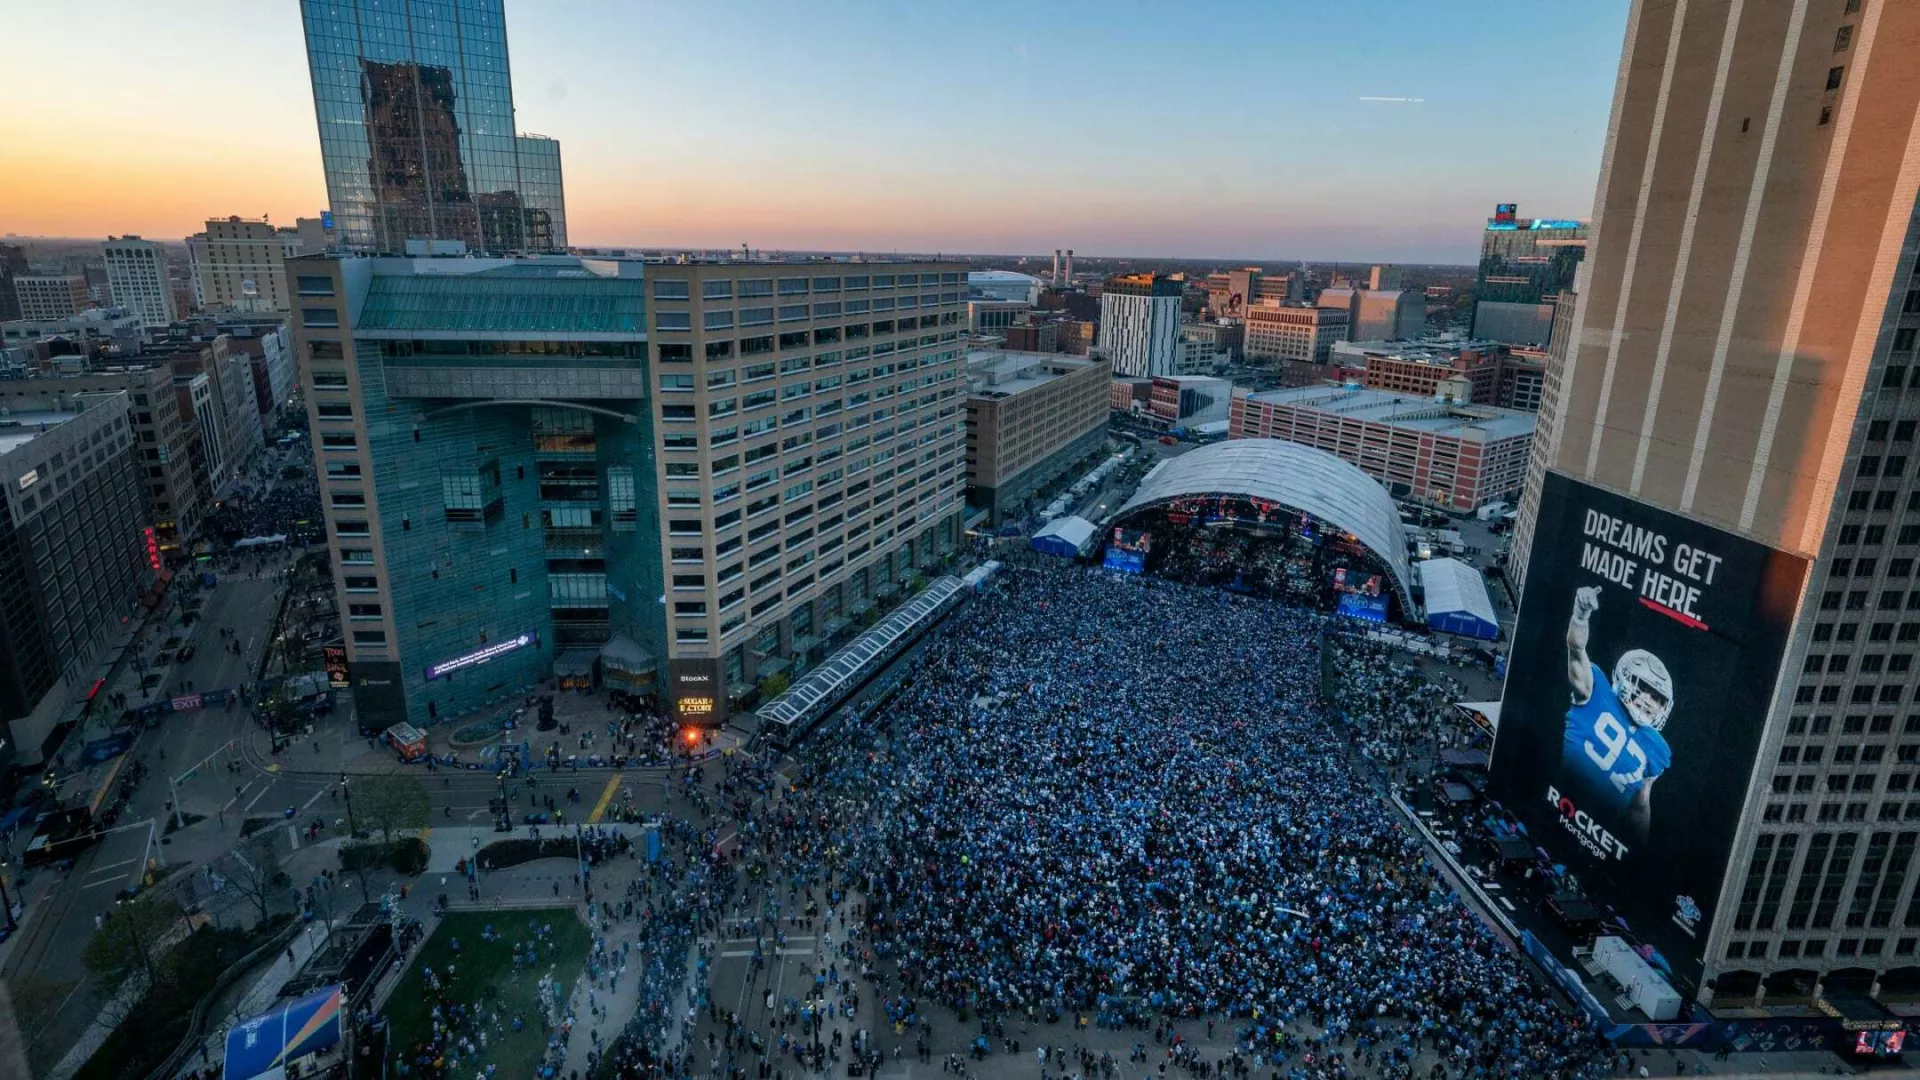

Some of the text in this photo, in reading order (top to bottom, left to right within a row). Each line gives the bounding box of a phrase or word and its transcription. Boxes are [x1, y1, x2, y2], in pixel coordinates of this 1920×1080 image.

[1581, 542, 1702, 622] MADE HERE.
[1584, 508, 1722, 585] DREAMS GET
[172, 698, 200, 710] EXIT
[1547, 785, 1629, 861] ROCKET
[1559, 814, 1606, 860] Mortgage
